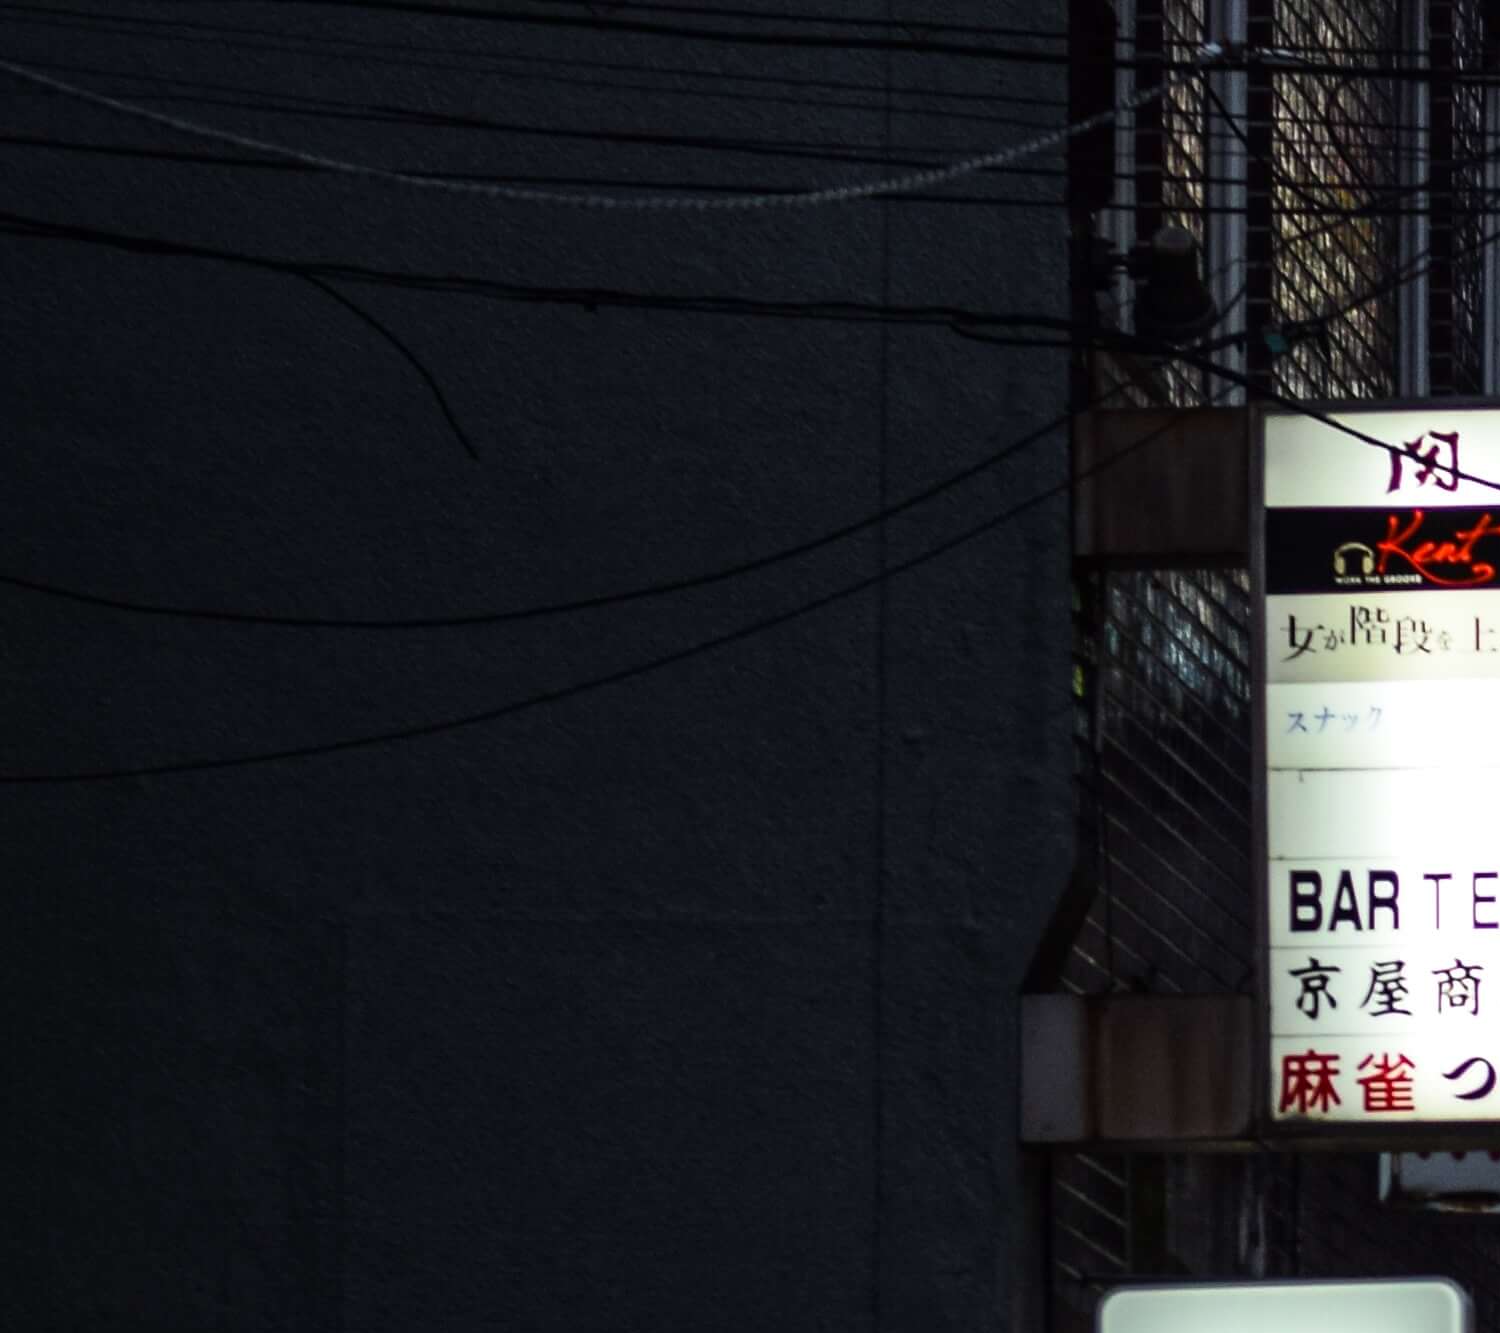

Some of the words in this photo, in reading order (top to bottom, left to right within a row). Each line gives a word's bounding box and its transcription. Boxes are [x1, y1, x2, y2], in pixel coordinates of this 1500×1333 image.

[1286, 705, 1383, 734] スナック
[1289, 869, 1400, 932] BAR
[1279, 1049, 1416, 1114] 麻雀
